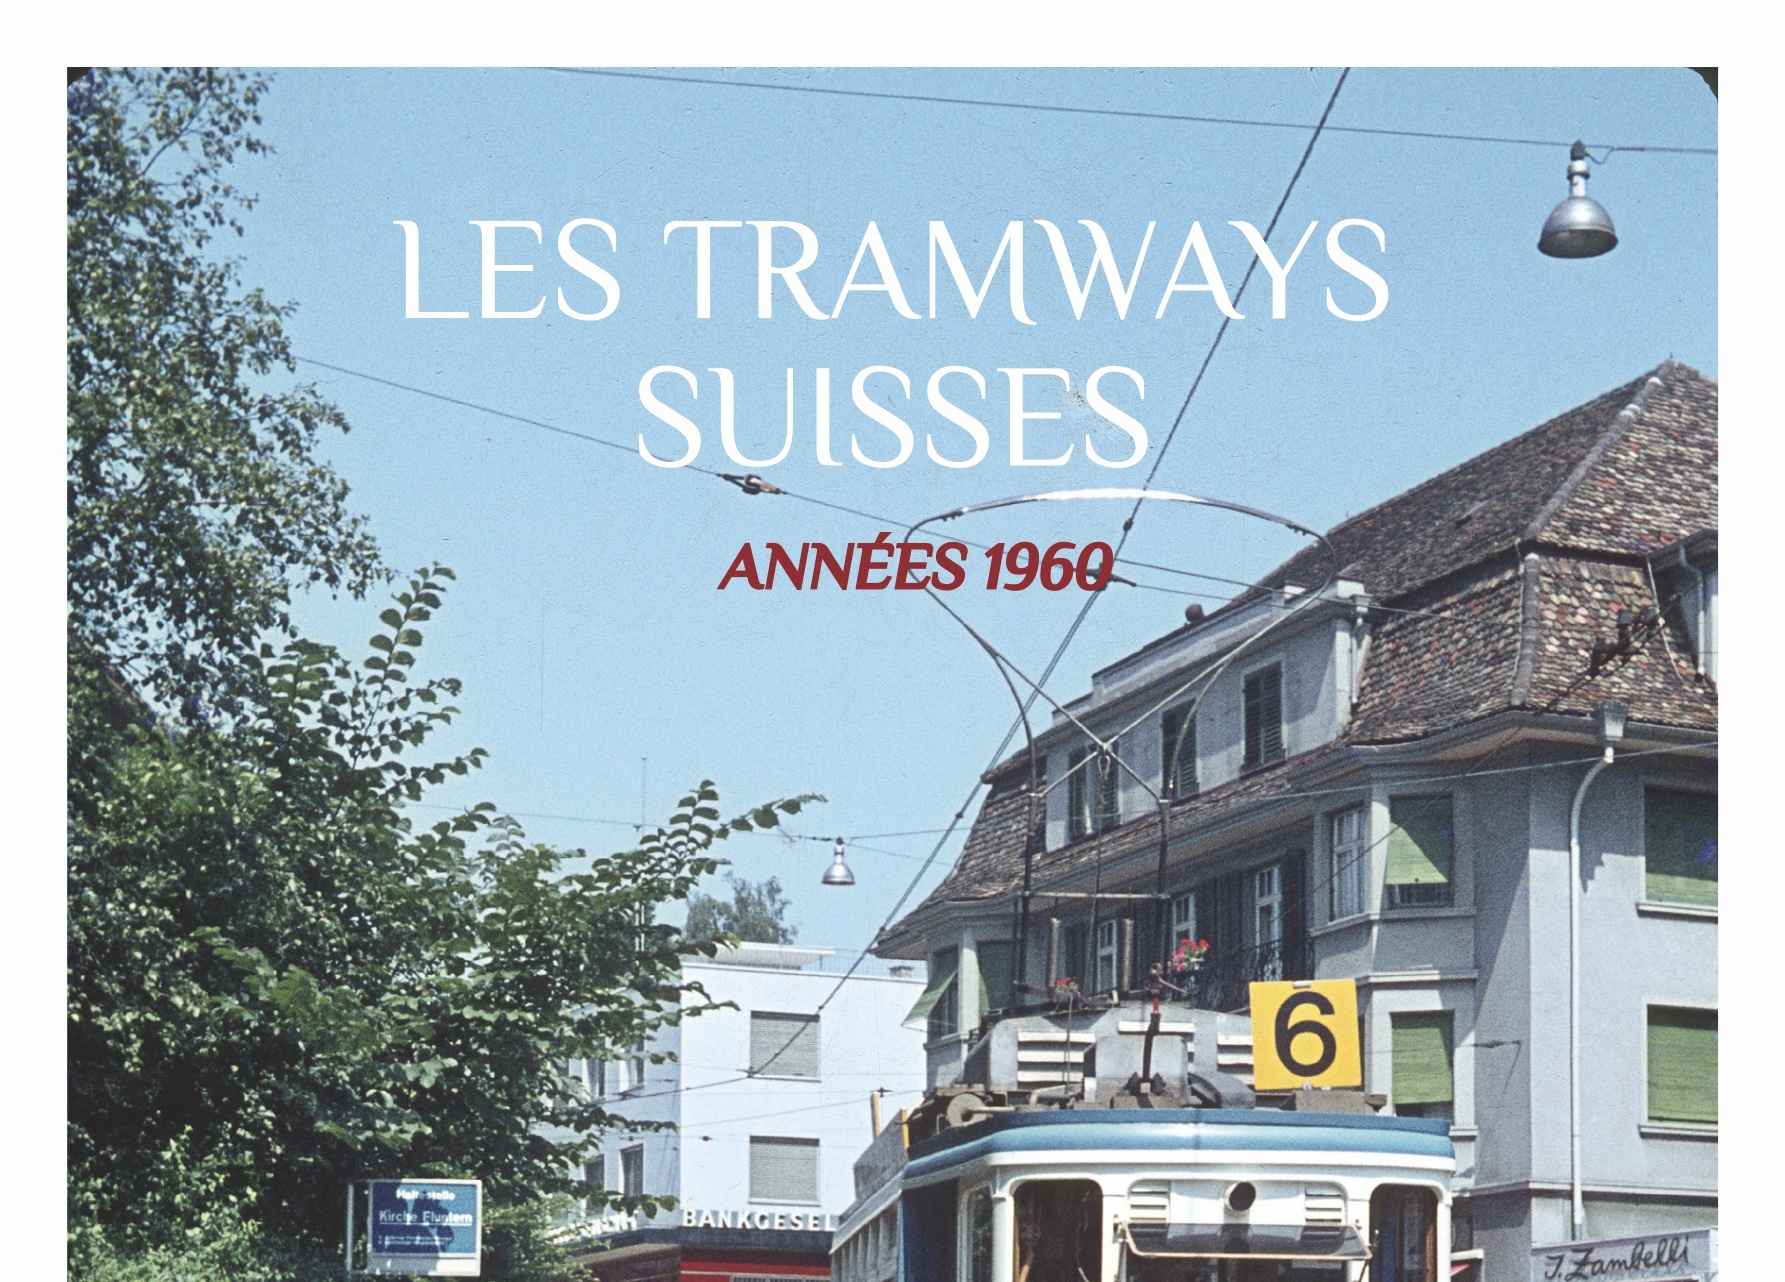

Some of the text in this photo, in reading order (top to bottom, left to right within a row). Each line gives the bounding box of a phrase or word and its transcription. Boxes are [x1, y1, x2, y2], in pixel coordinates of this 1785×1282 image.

[1275, 991, 1336, 1077] 6
[379, 1210, 473, 1223] Kirche Fluntern
[1565, 1235, 1692, 1281] Zambelli
